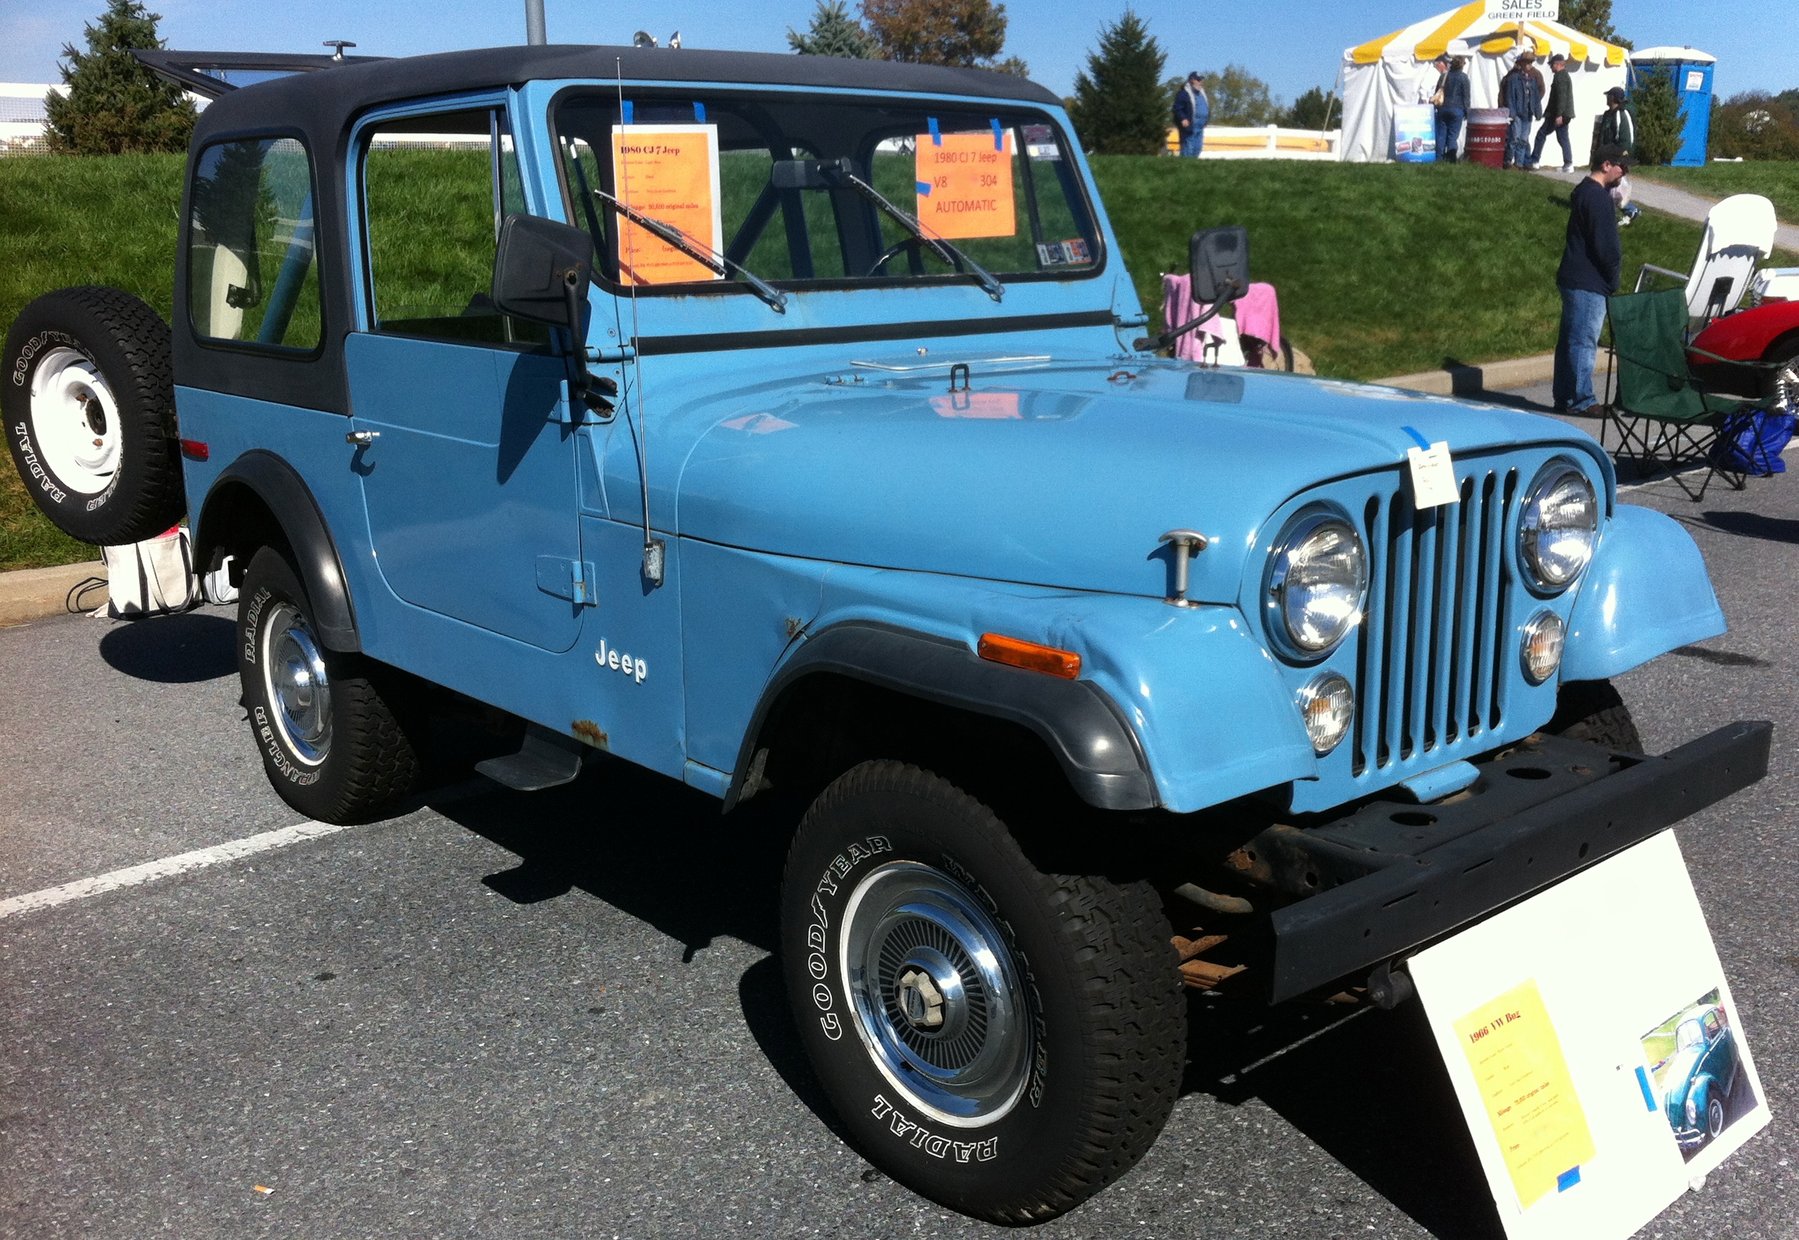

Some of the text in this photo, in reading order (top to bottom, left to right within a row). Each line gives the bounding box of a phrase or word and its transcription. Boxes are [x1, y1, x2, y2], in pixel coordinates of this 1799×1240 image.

[1502, 0, 1543, 10] SALES
[1488, 10, 1556, 20] GREEN FIELD
[643, 146, 654, 154] CJ
[656, 146, 662, 155] 7
[663, 146, 680, 156] Jeep
[934, 151, 998, 164] 1980 CJ 7 Jeep
[934, 175, 998, 188] V8 304
[936, 199, 998, 214] AUTOMATIC
[15, 421, 66, 504] RADIAL
[244, 586, 272, 665] RADIAL
[594, 638, 648, 684] Jeep
[1469, 1026, 1489, 1044] 1966
[1490, 1017, 1504, 1031] VW
[872, 1094, 998, 1164] RADIAL
